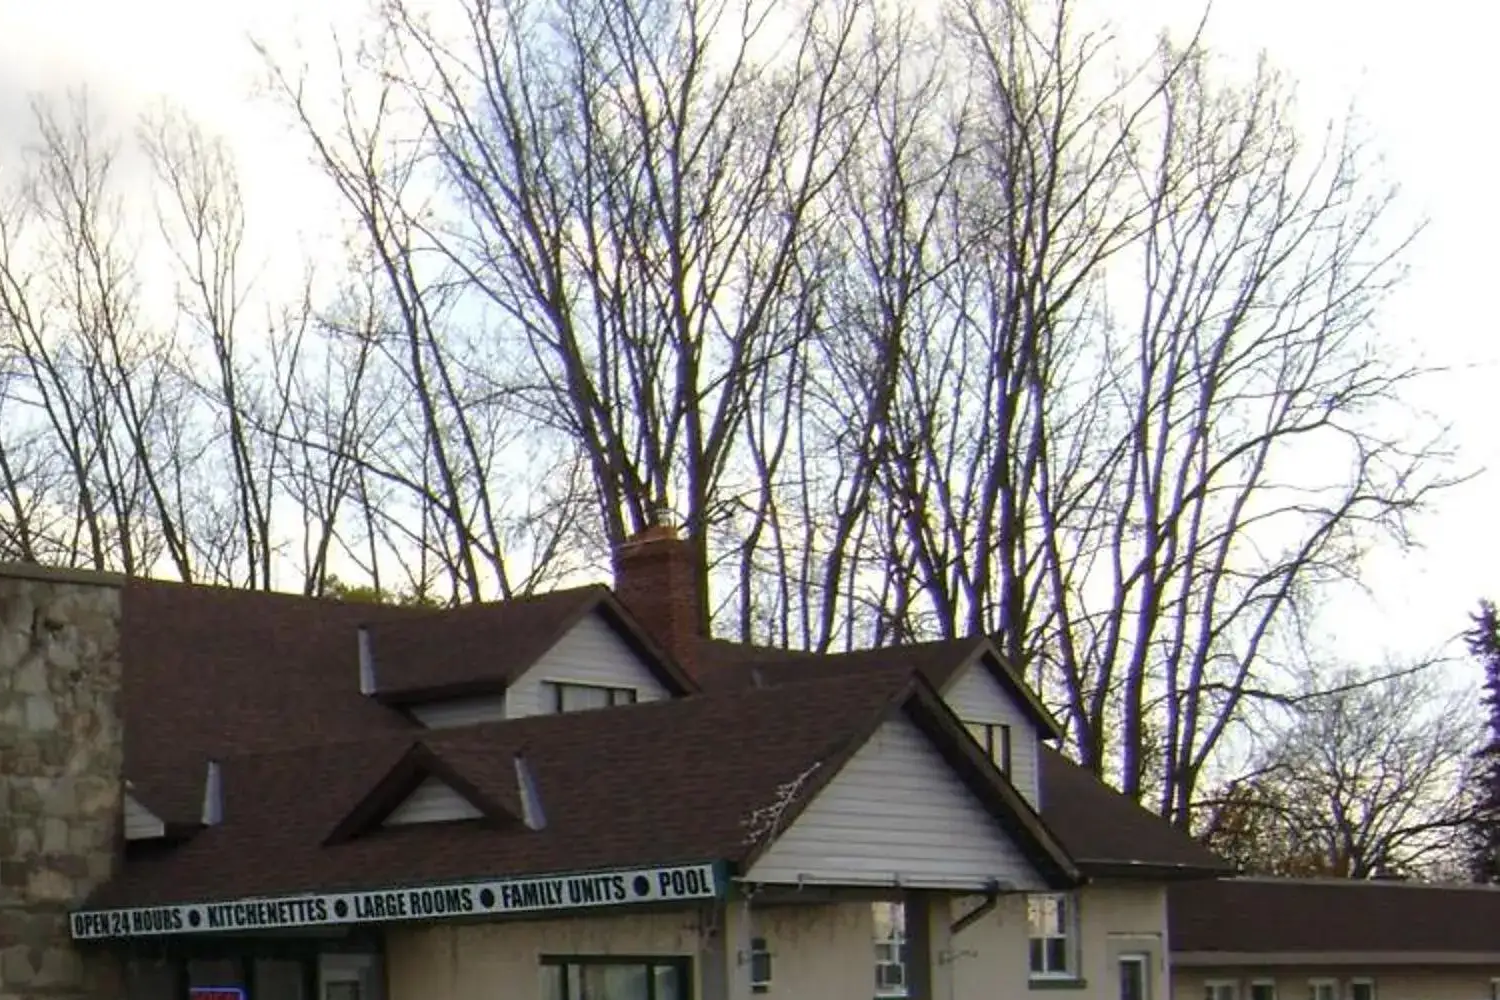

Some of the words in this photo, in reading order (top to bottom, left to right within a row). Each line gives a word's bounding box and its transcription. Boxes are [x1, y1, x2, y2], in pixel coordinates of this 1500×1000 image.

[74, 912, 110, 937] OPEN
[112, 911, 131, 935] 24
[132, 907, 182, 932] HOURS
[206, 898, 328, 928] KITCHENETTES
[354, 893, 406, 919] LARGE
[409, 887, 474, 915] ROOMS
[501, 878, 563, 909] FAMILY
[568, 875, 627, 903] UNITS
[659, 869, 712, 897] POOL
